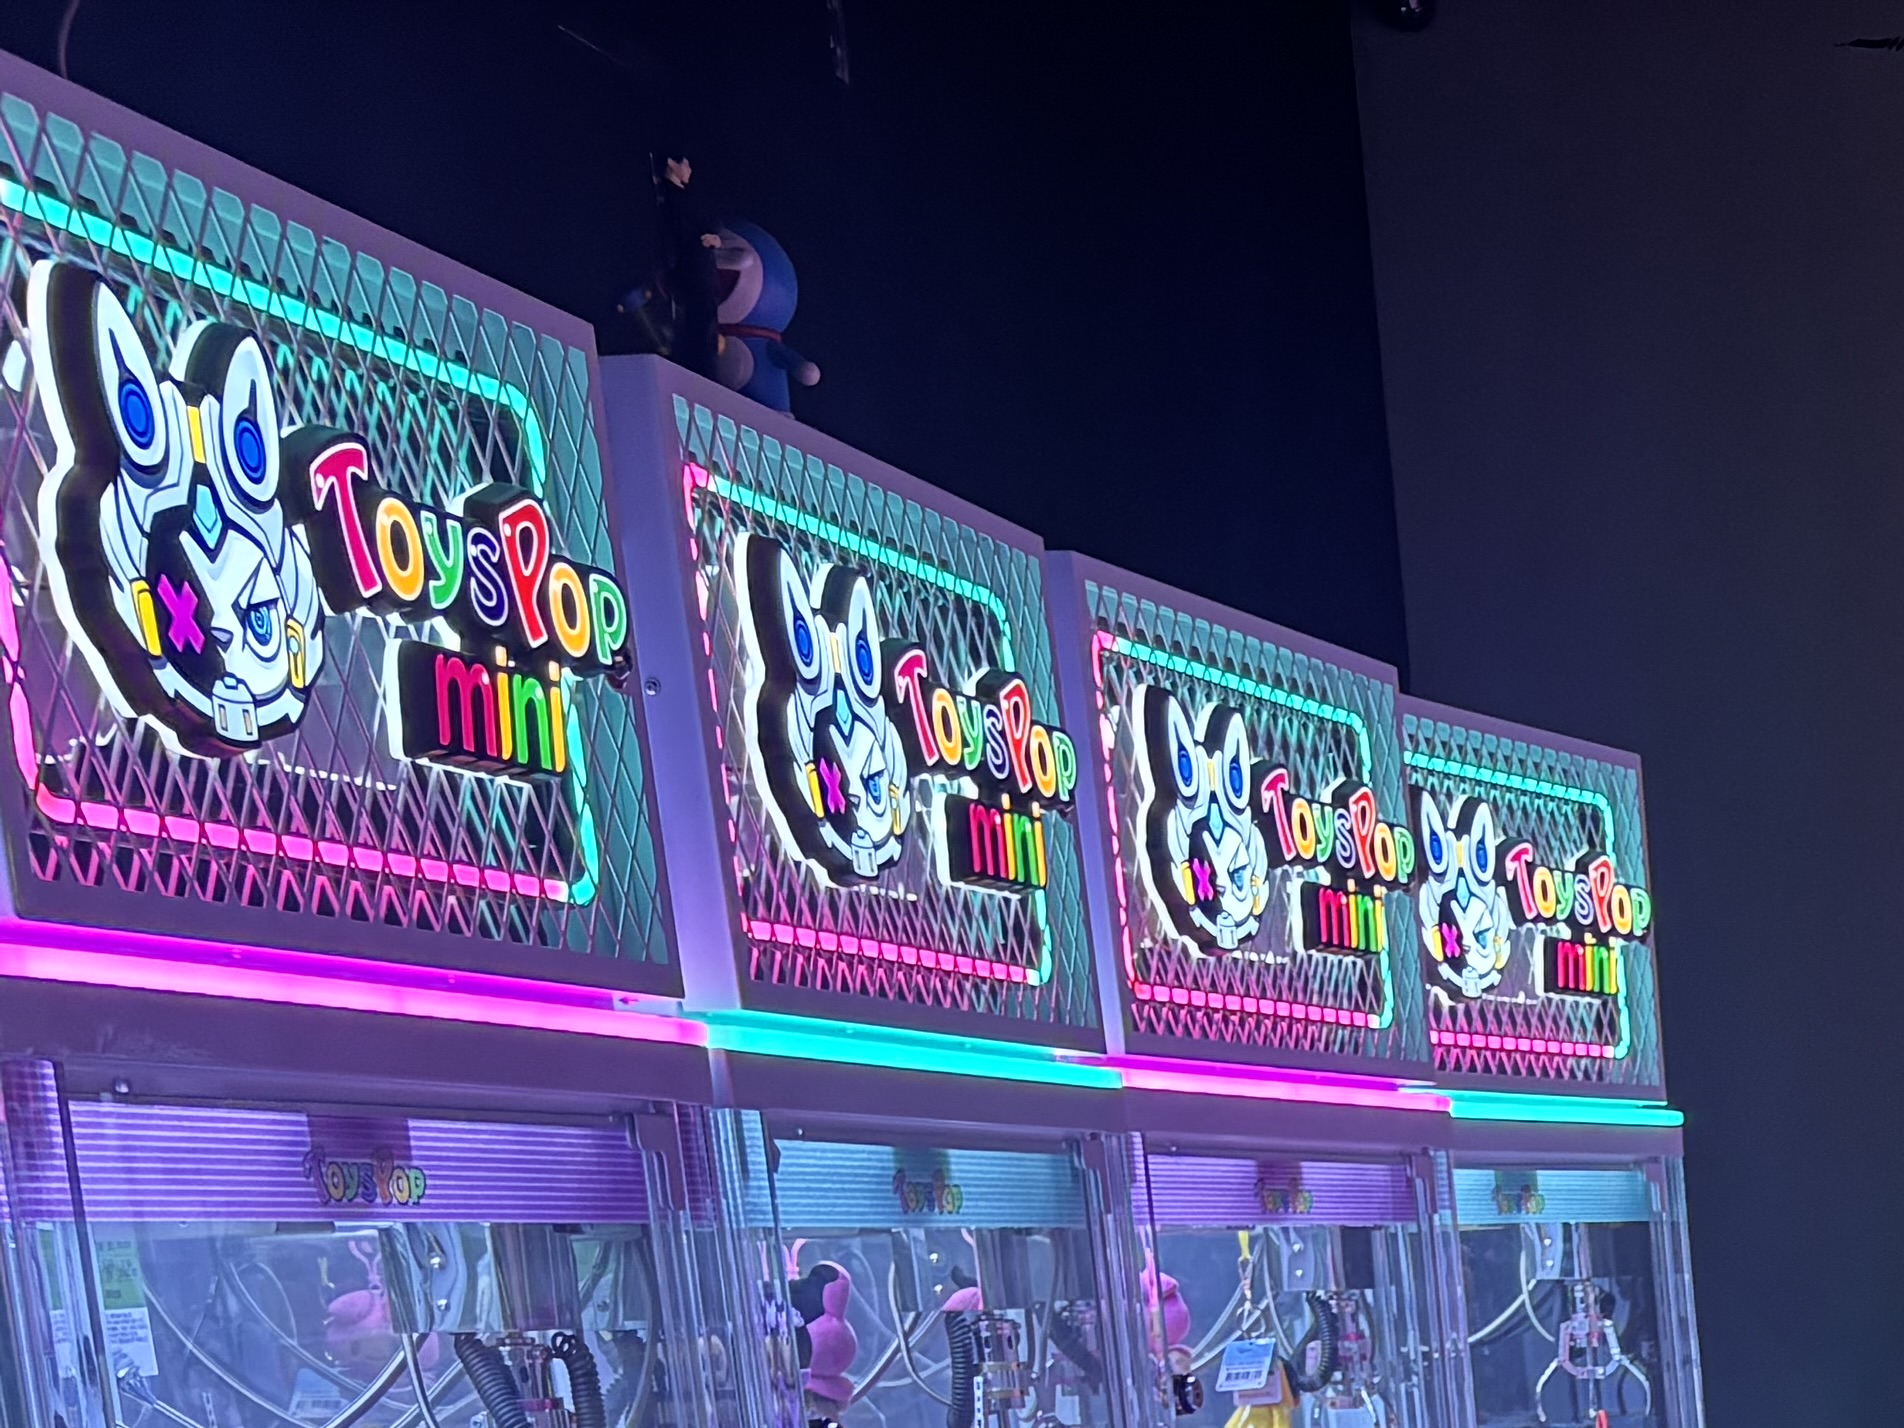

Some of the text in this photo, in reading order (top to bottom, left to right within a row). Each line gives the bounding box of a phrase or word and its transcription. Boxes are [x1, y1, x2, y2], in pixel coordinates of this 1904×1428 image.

[434, 644, 568, 774] mini
[969, 792, 1046, 887] mini
[1319, 879, 1386, 952] mini
[1557, 933, 1618, 994] mini
